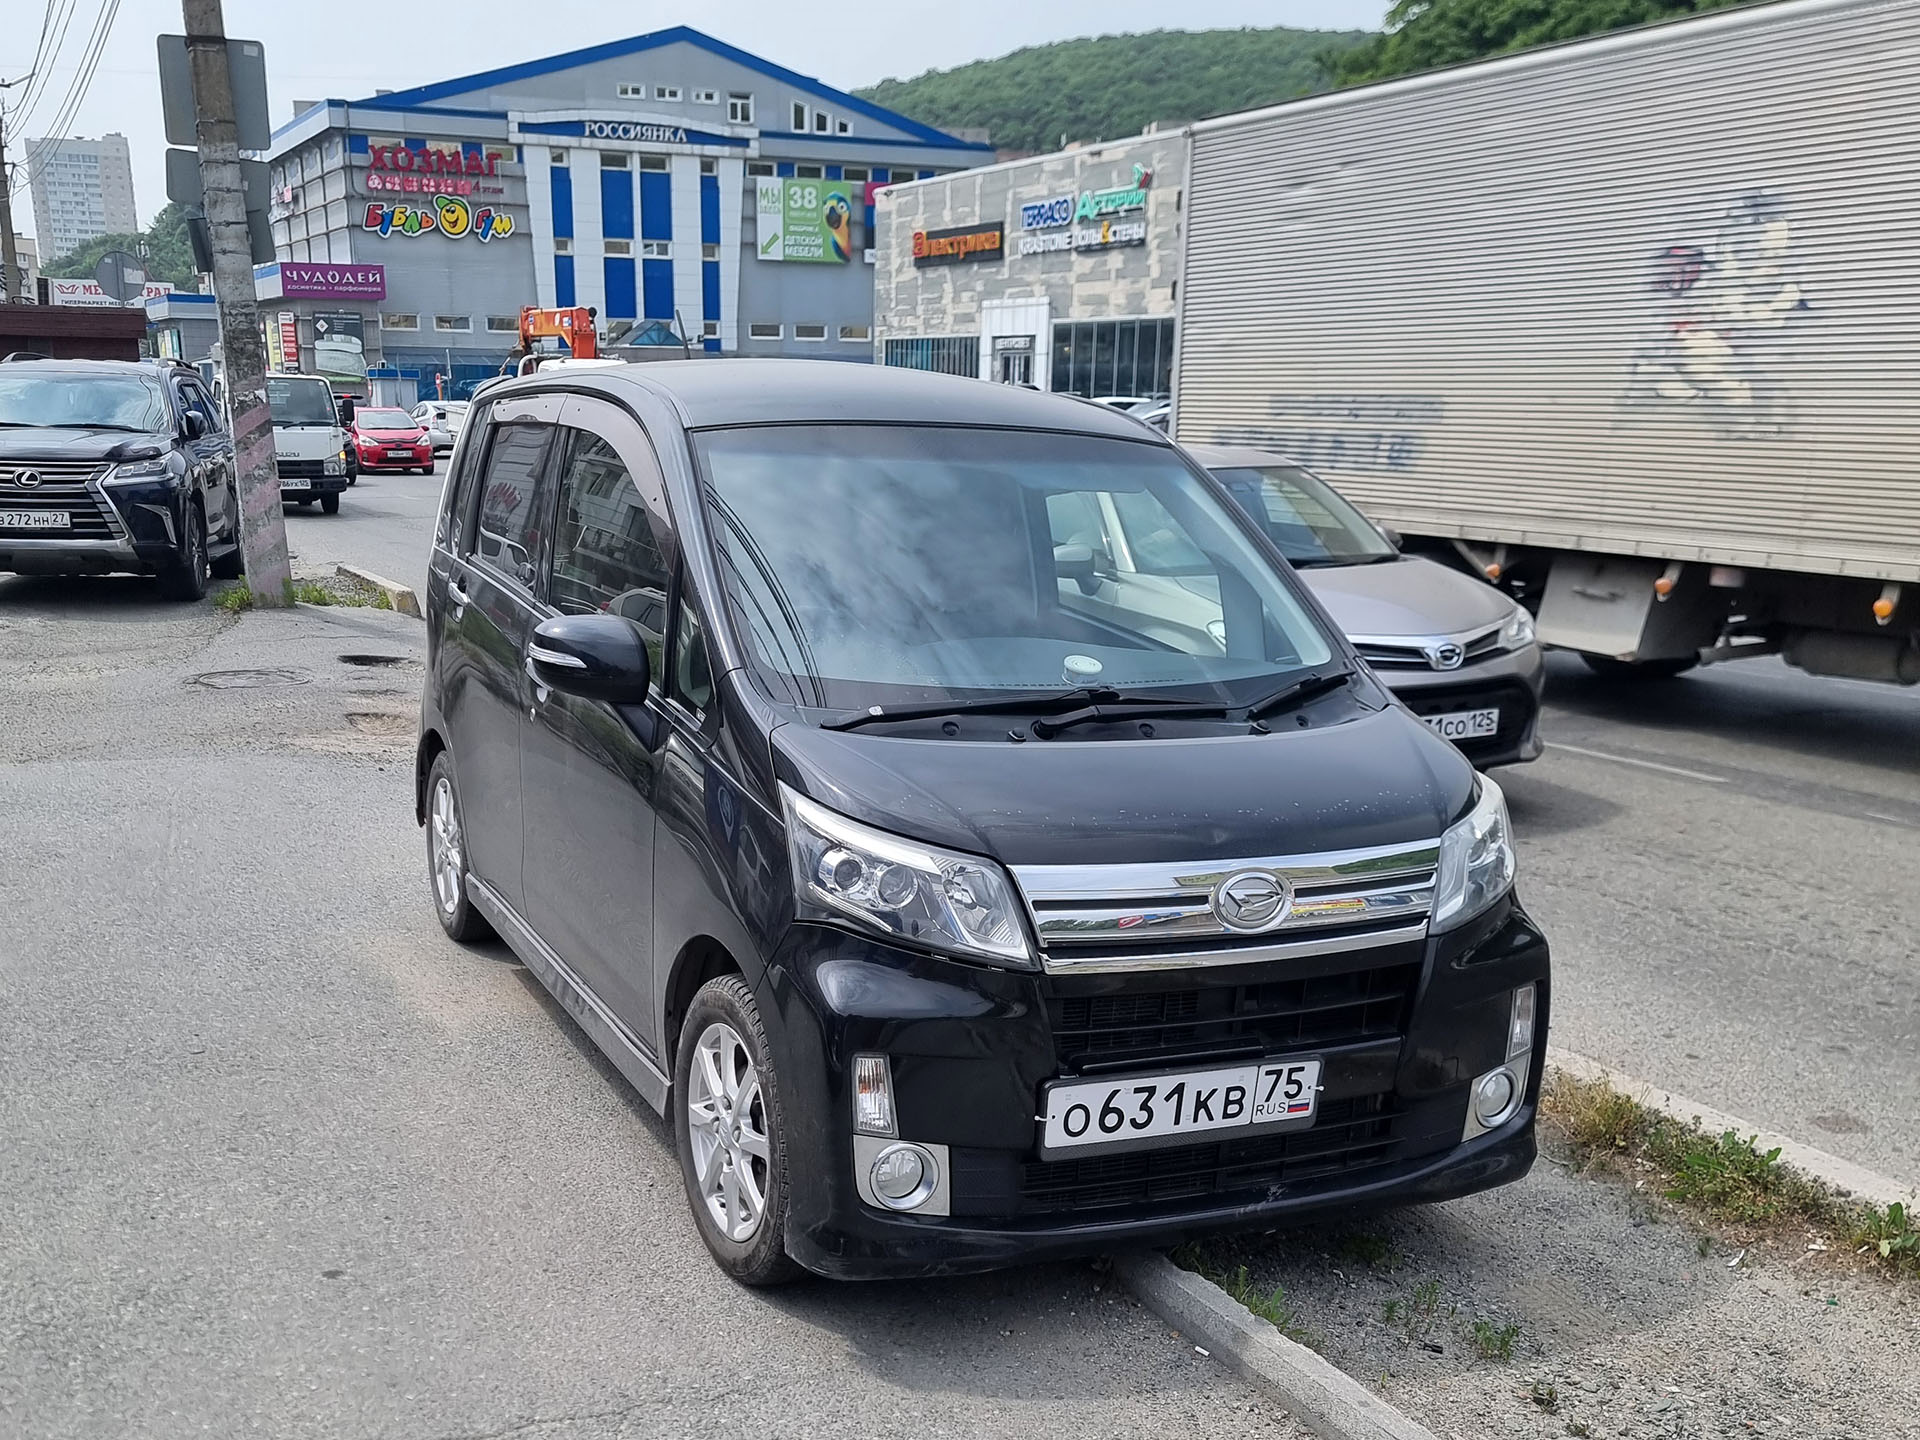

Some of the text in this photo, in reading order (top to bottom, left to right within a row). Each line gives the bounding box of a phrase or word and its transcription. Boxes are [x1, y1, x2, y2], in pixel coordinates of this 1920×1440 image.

[584, 121, 688, 143] РОССИЯНКА
[368, 145, 502, 177] ХОЗМАГ
[759, 186, 782, 204] МЫ
[788, 186, 818, 210] 38
[285, 270, 381, 284] ЧУДОДЕЙ
[52, 513, 65, 523] 27
[1470, 711, 1495, 729] 125
[1264, 1066, 1306, 1103] 75
[1255, 1102, 1287, 1117] RUS
